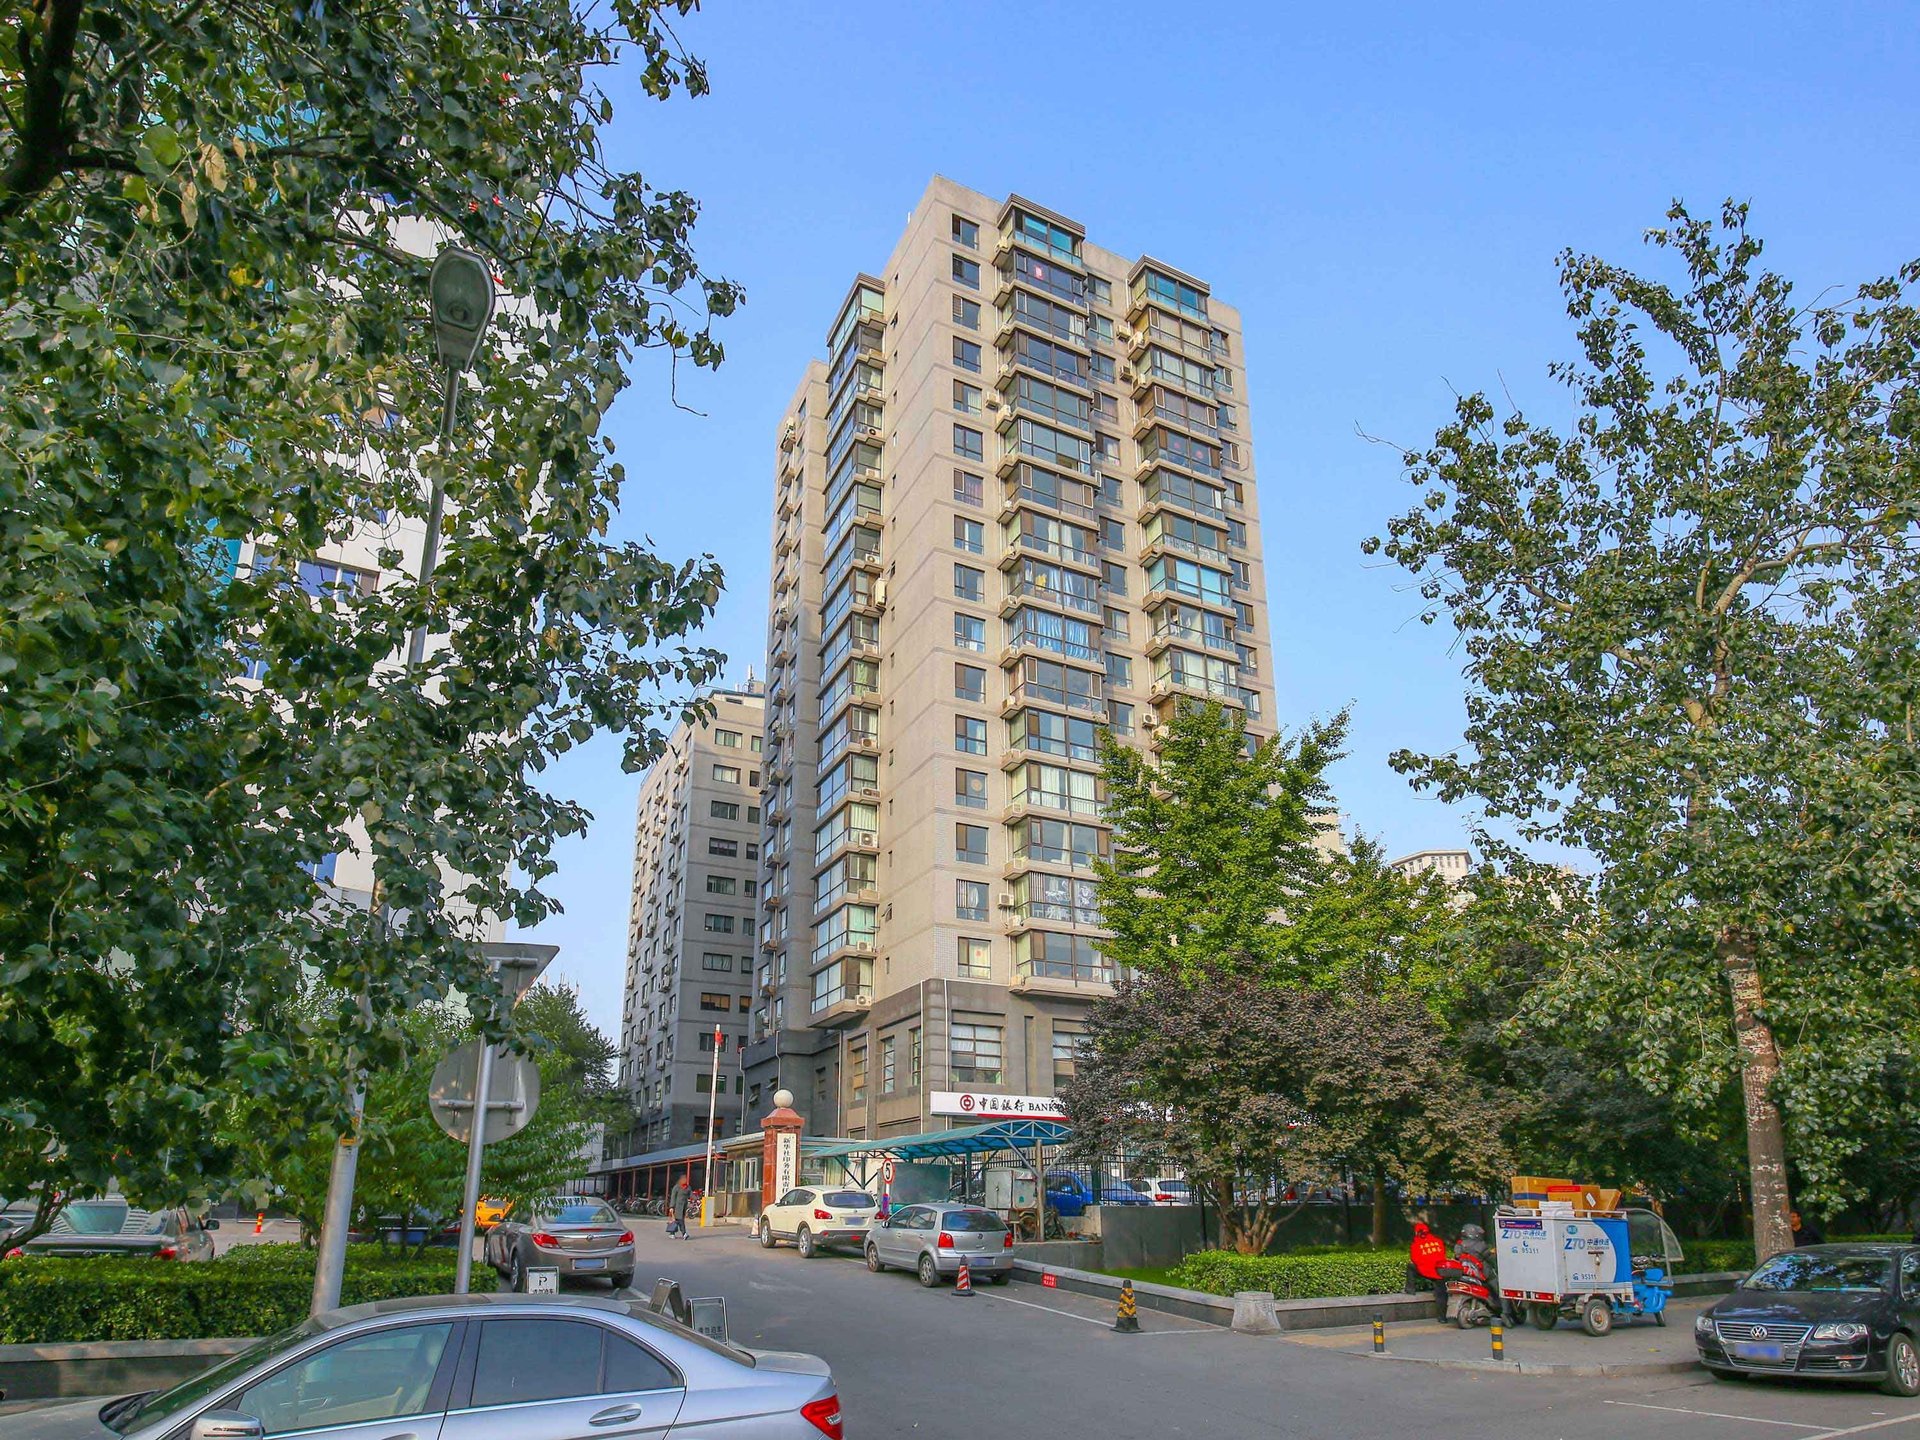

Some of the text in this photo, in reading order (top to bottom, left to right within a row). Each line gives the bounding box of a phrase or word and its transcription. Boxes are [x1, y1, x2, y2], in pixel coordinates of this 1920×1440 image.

[978, 1097, 1055, 1113] 中国银行 BANK
[885, 1162, 891, 1180] 5
[1564, 1238, 1586, 1250] ZTO
